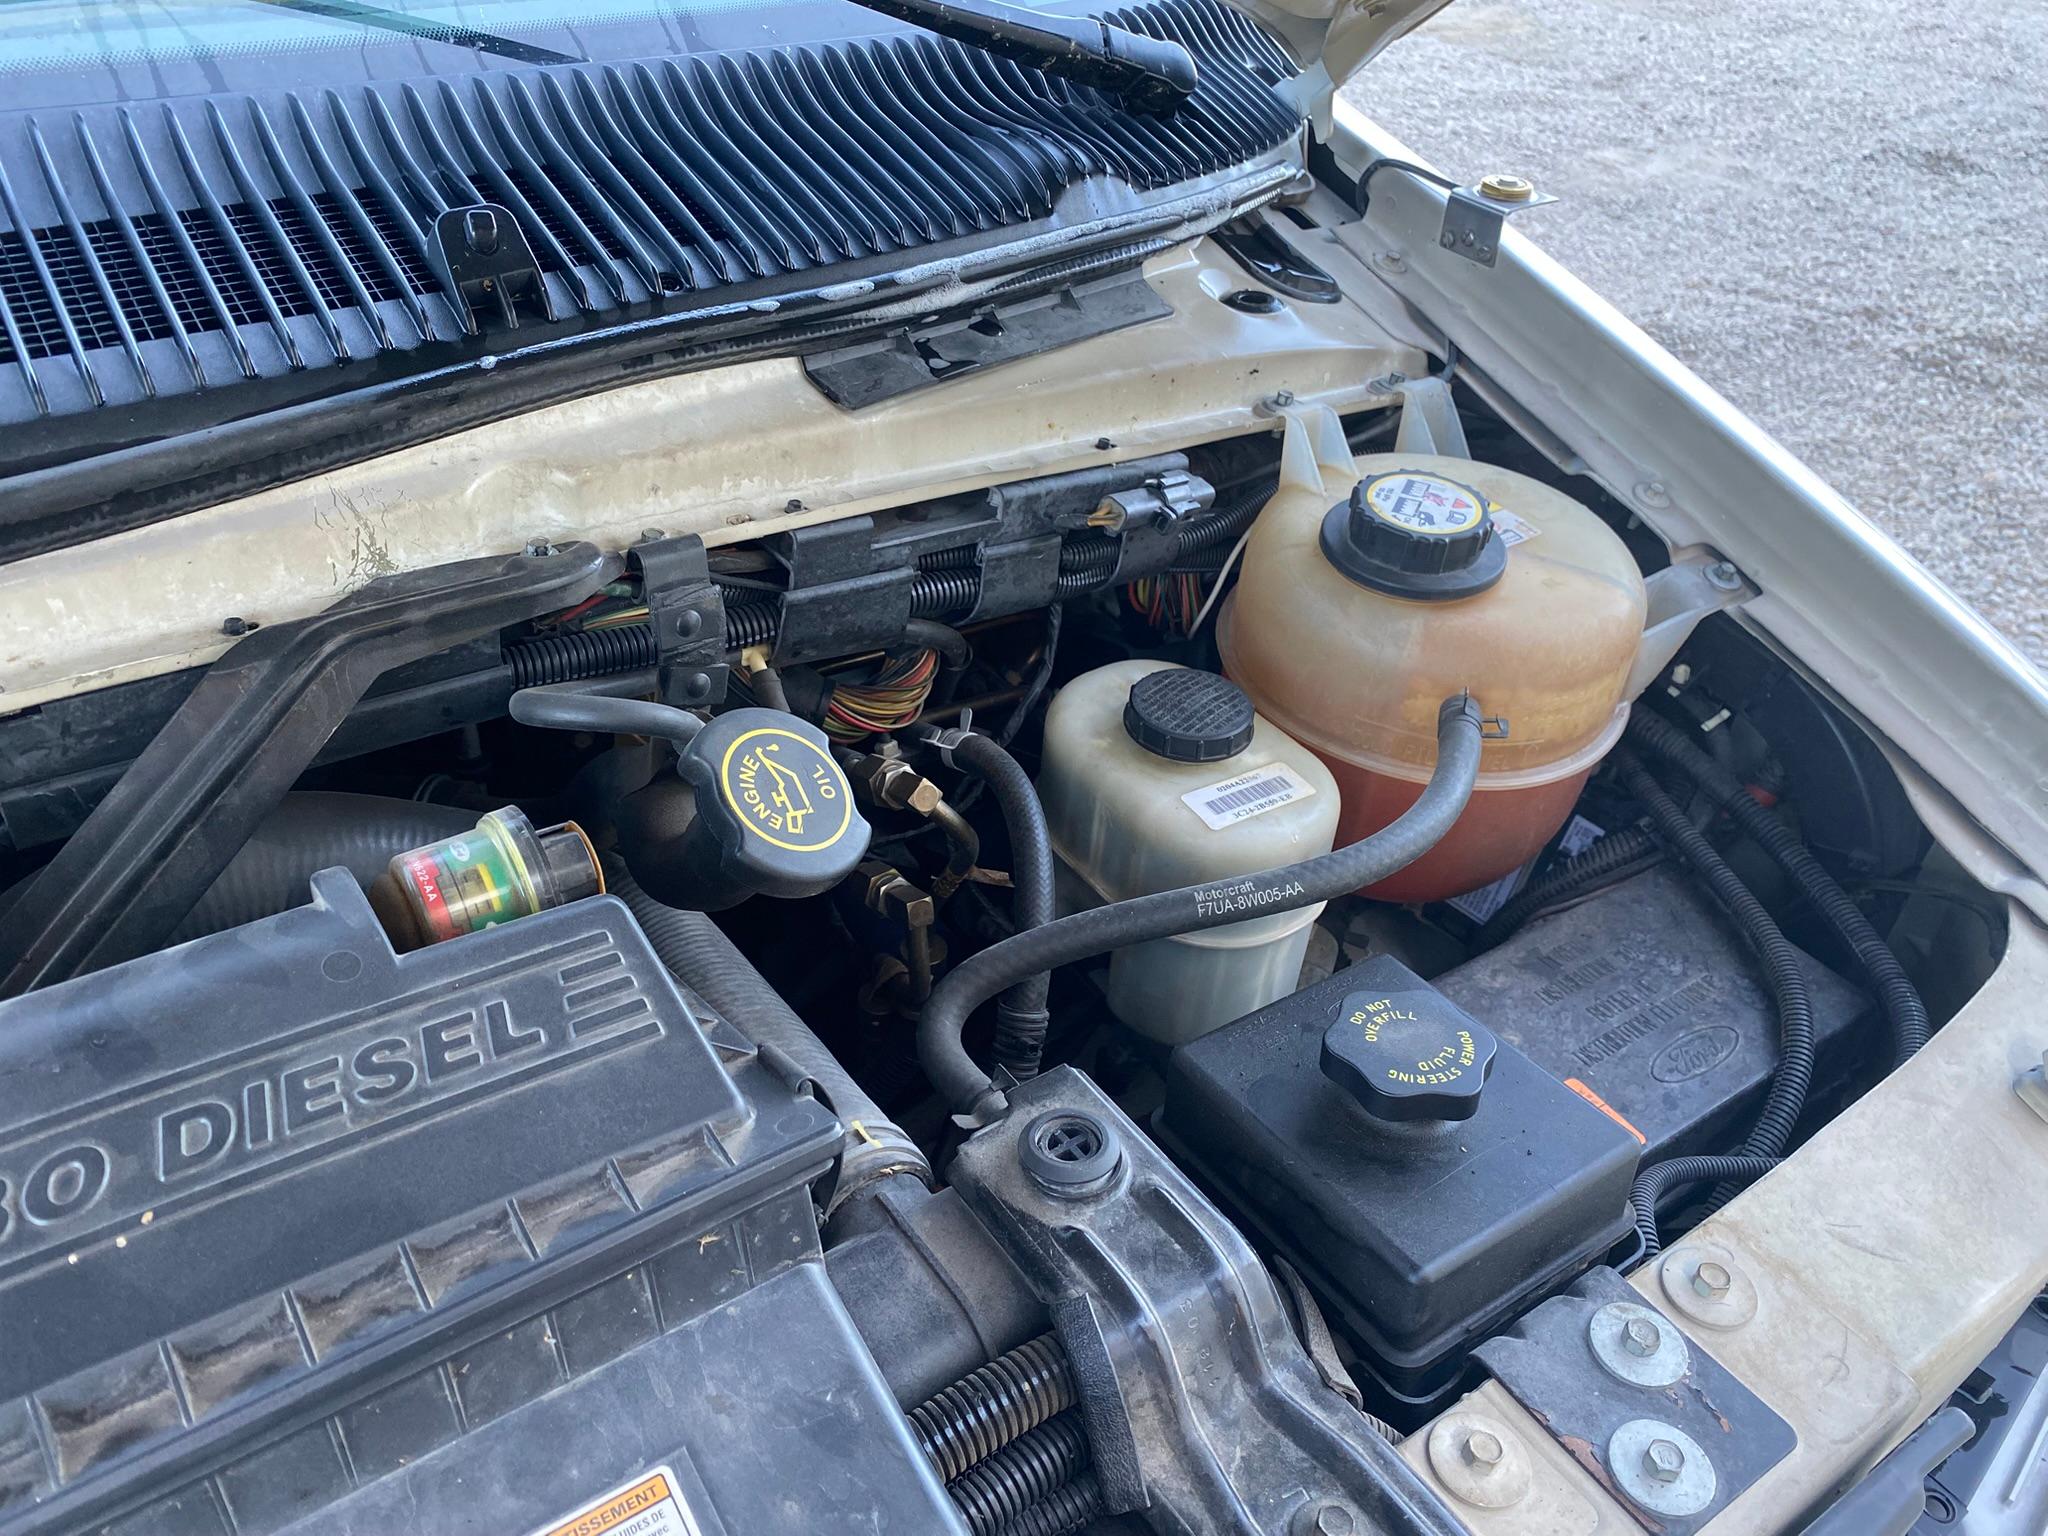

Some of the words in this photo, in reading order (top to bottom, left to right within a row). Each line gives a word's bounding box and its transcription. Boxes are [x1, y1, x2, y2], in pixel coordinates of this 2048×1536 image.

[739, 755, 784, 831] ENGINE
[812, 764, 836, 799] OIL
[1194, 881, 1255, 902] Motorcraft
[1197, 882, 1304, 917] F7UA-8W005-AA
[1350, 1011, 1366, 1025] DO
[1365, 999, 1392, 1013] NOT
[1366, 1010, 1417, 1042] OVERFILL
[1418, 1046, 1456, 1071] FLUID
[1456, 1030, 1475, 1066] POWER
[1663, 1031, 1727, 1079] Ford
[1388, 1067, 1463, 1085] STEERING
[0, 1142, 111, 1240] O
[156, 999, 547, 1184] DIESEL
[650, 1509, 666, 1523] DE
